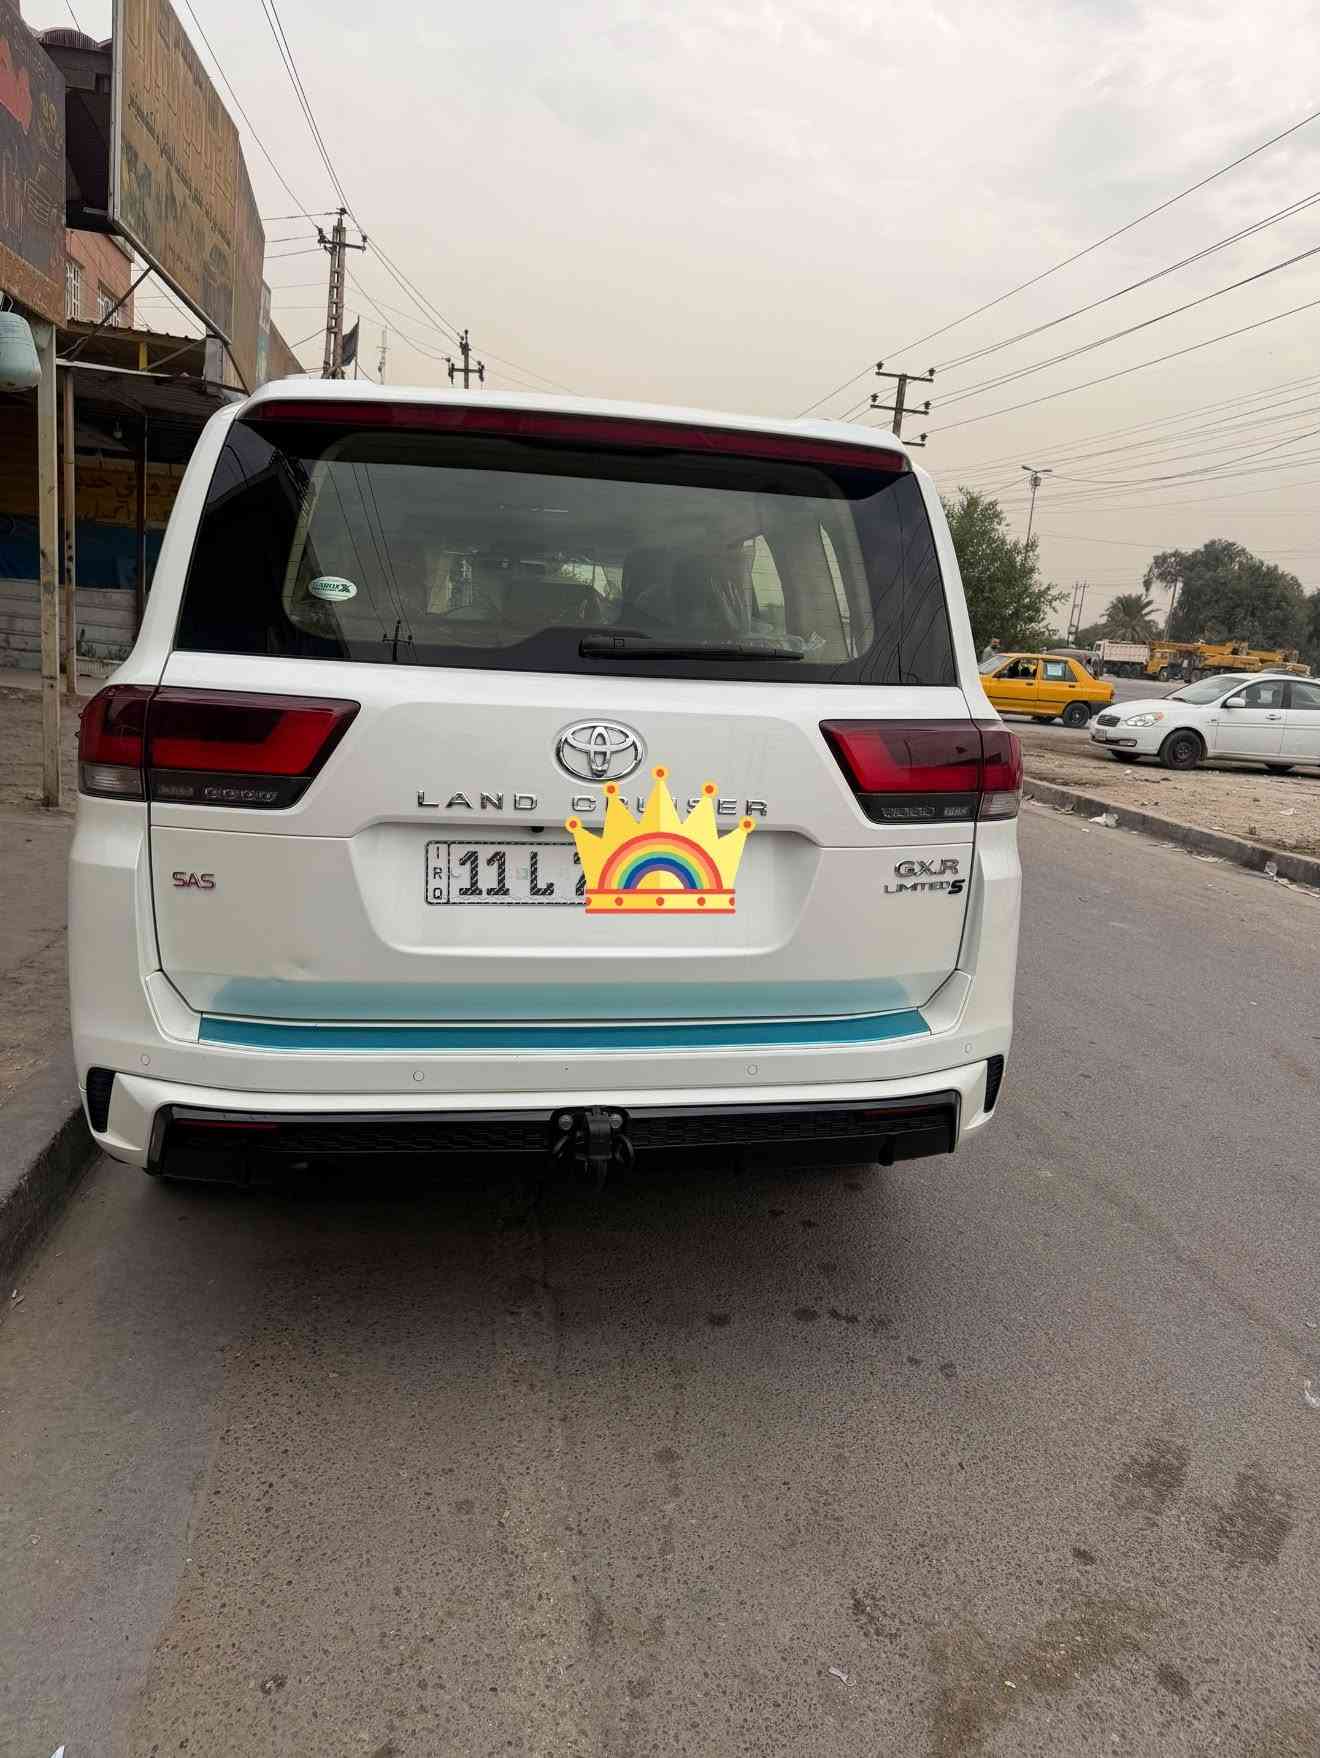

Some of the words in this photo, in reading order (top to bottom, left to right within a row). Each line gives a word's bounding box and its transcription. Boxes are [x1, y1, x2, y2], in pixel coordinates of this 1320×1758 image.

[417, 790, 538, 811] LAND
[458, 850, 510, 896] 11
[893, 858, 960, 878] GXR
[172, 871, 217, 890] SAS
